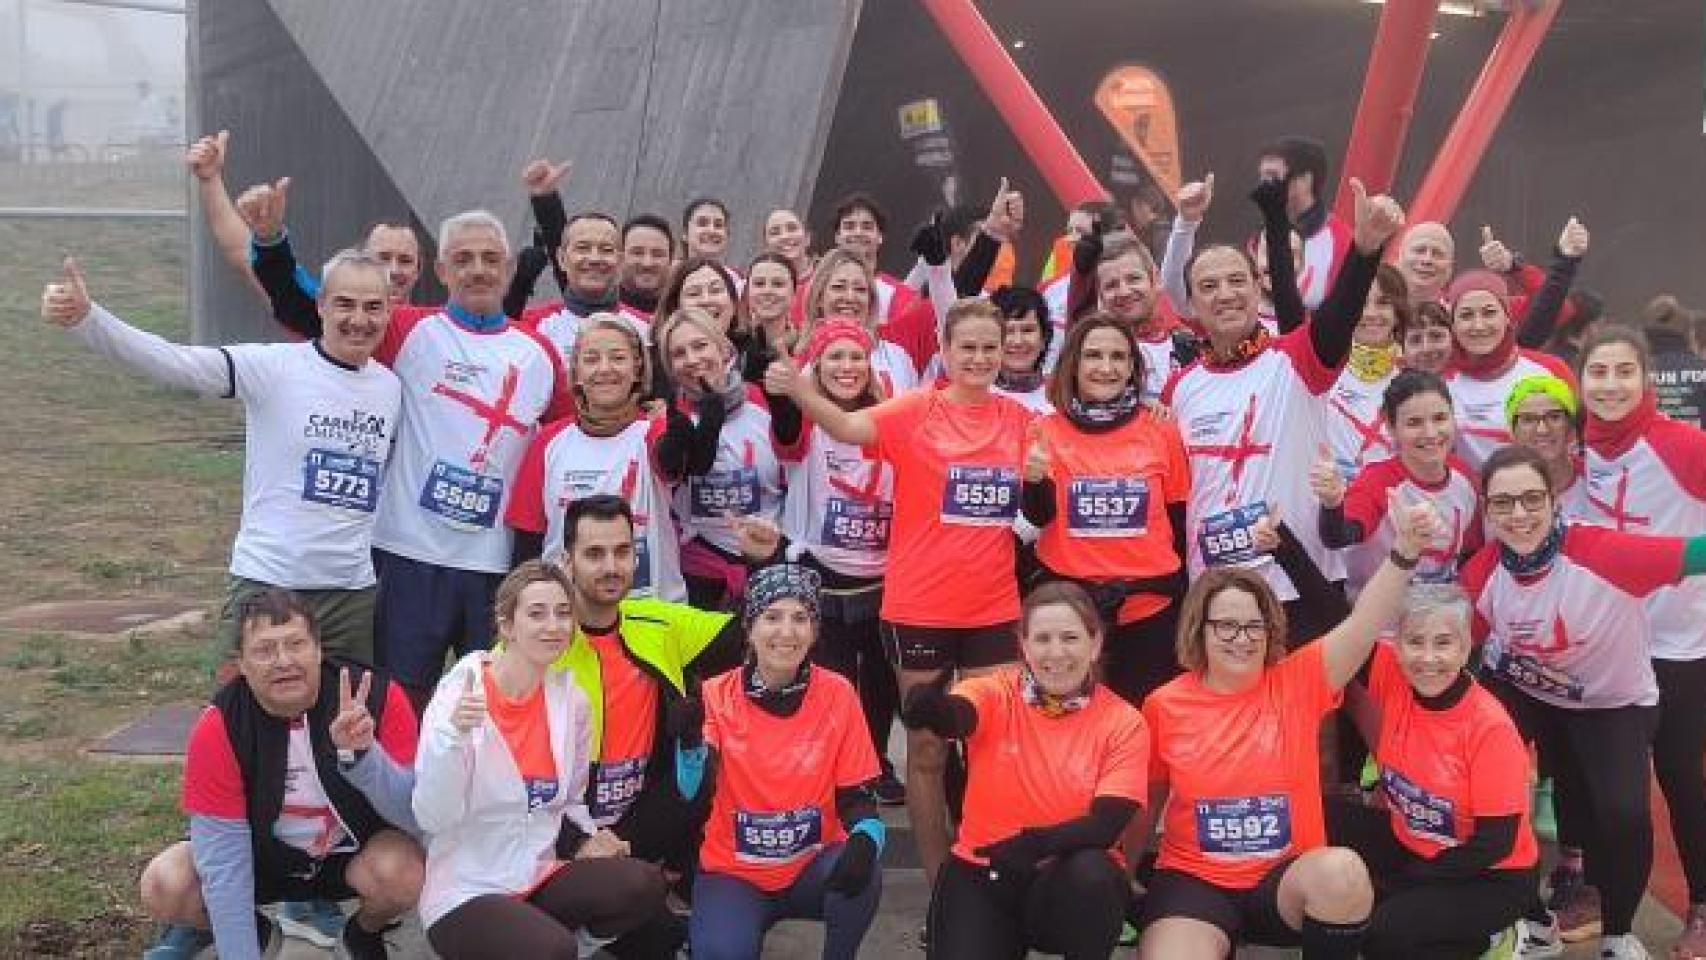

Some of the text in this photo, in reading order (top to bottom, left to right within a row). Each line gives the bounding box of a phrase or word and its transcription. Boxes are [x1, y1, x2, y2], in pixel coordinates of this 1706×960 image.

[315, 470, 369, 498] 5773
[955, 484, 1011, 505] 5538
[1078, 497, 1140, 516] 5537
[745, 822, 811, 845] 5597
[1208, 815, 1281, 839] 5592
